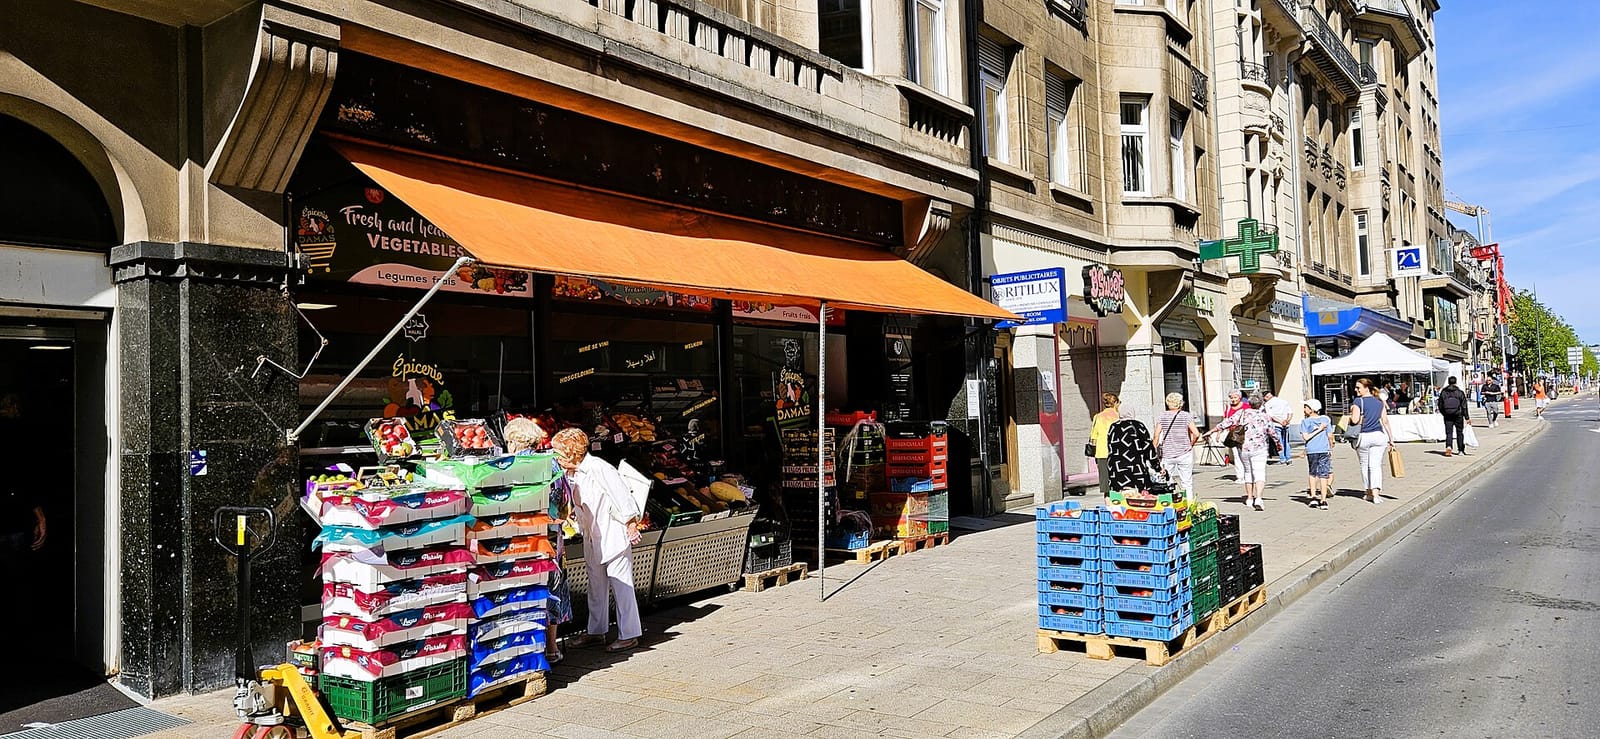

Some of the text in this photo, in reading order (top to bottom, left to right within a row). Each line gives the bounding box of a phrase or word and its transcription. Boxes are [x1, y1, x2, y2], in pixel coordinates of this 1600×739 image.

[339, 205, 383, 232] Fresh
[388, 217, 415, 234] and
[299, 235, 336, 243] DAMAS
[367, 233, 465, 258] VEGETABLES
[378, 270, 427, 284] Legumes
[992, 271, 1058, 284] OBJETS PUBLICITAIRES
[1005, 281, 1058, 297] RITILUX
[782, 311, 798, 319] Fruits
[392, 353, 445, 386] Épicerie
[776, 404, 811, 421] DAMAS
[421, 553, 443, 561] Parsley
[512, 565, 533, 573] Parsley
[423, 611, 446, 620] Parsley
[424, 642, 447, 652] Parsley
